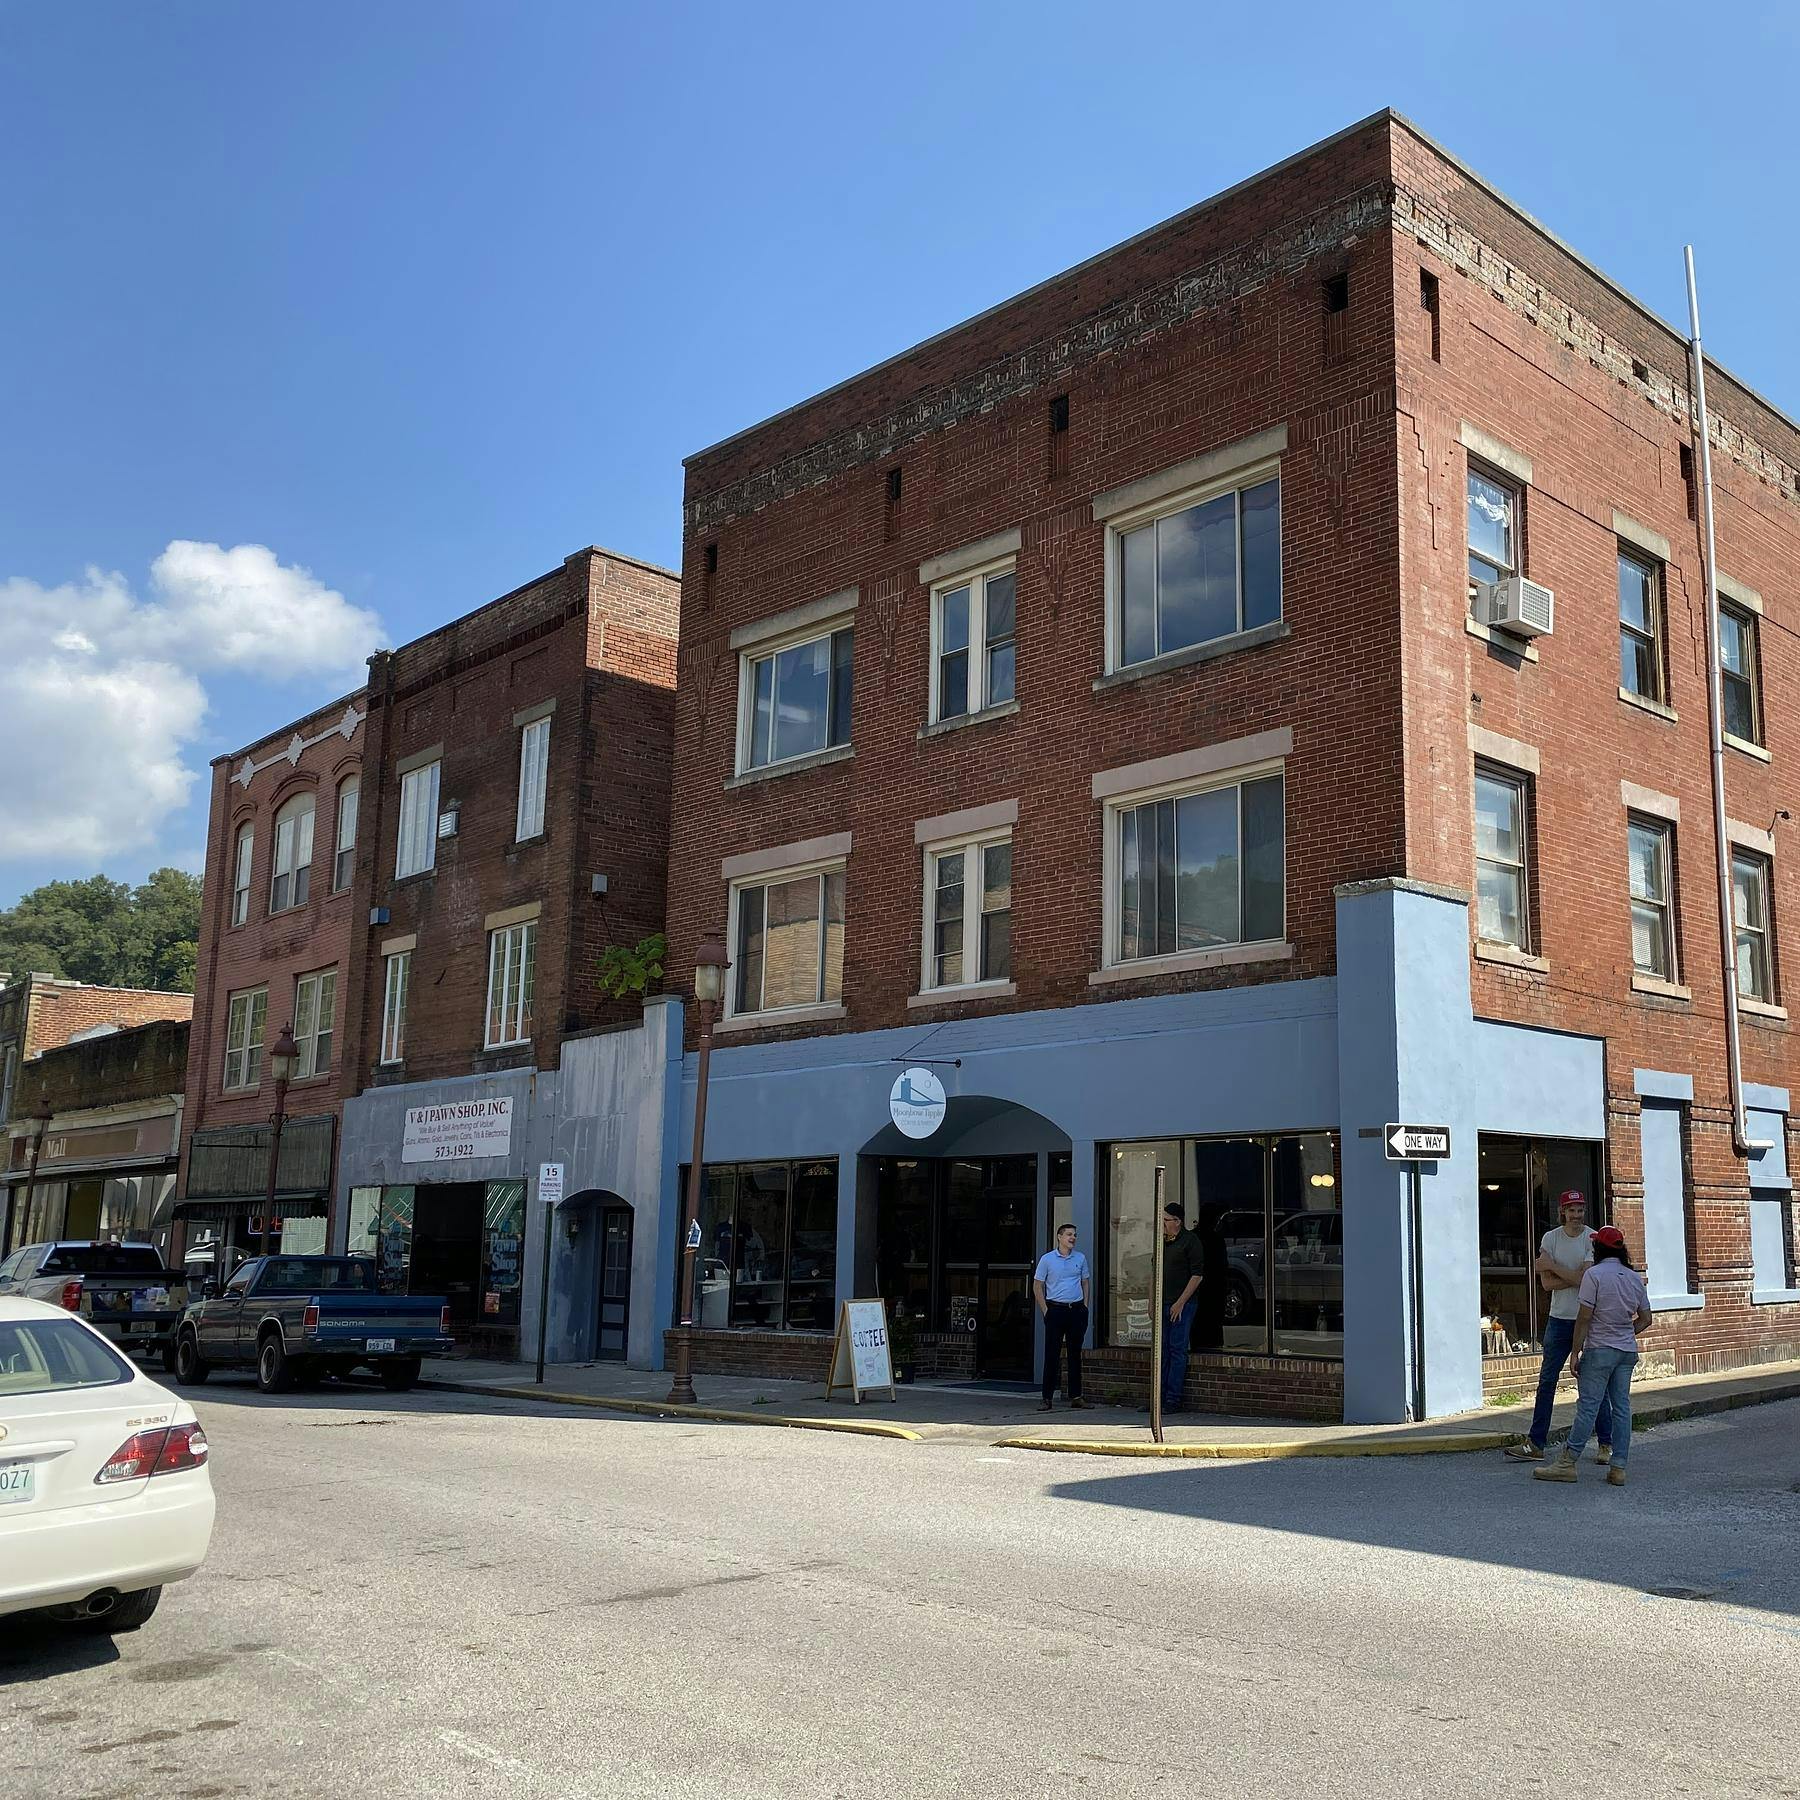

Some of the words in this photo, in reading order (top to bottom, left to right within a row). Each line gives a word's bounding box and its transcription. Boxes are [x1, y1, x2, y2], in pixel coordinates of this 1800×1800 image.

[410, 1112, 417, 1124] V
[417, 1111, 424, 1124] &
[424, 1110, 429, 1125] J
[429, 1107, 457, 1122] PAWN
[457, 1103, 486, 1119] SHOP,
[487, 1101, 509, 1116] INC.
[450, 1121, 473, 1132] Anything
[1404, 1135, 1422, 1148] ONE
[1424, 1135, 1443, 1149] WAY
[435, 1144, 474, 1158] 573-1922
[546, 1167, 558, 1177] 15
[489, 1232, 517, 1254] Pawn
[491, 1252, 517, 1274] Shop
[853, 1328, 885, 1348] COFFEE
